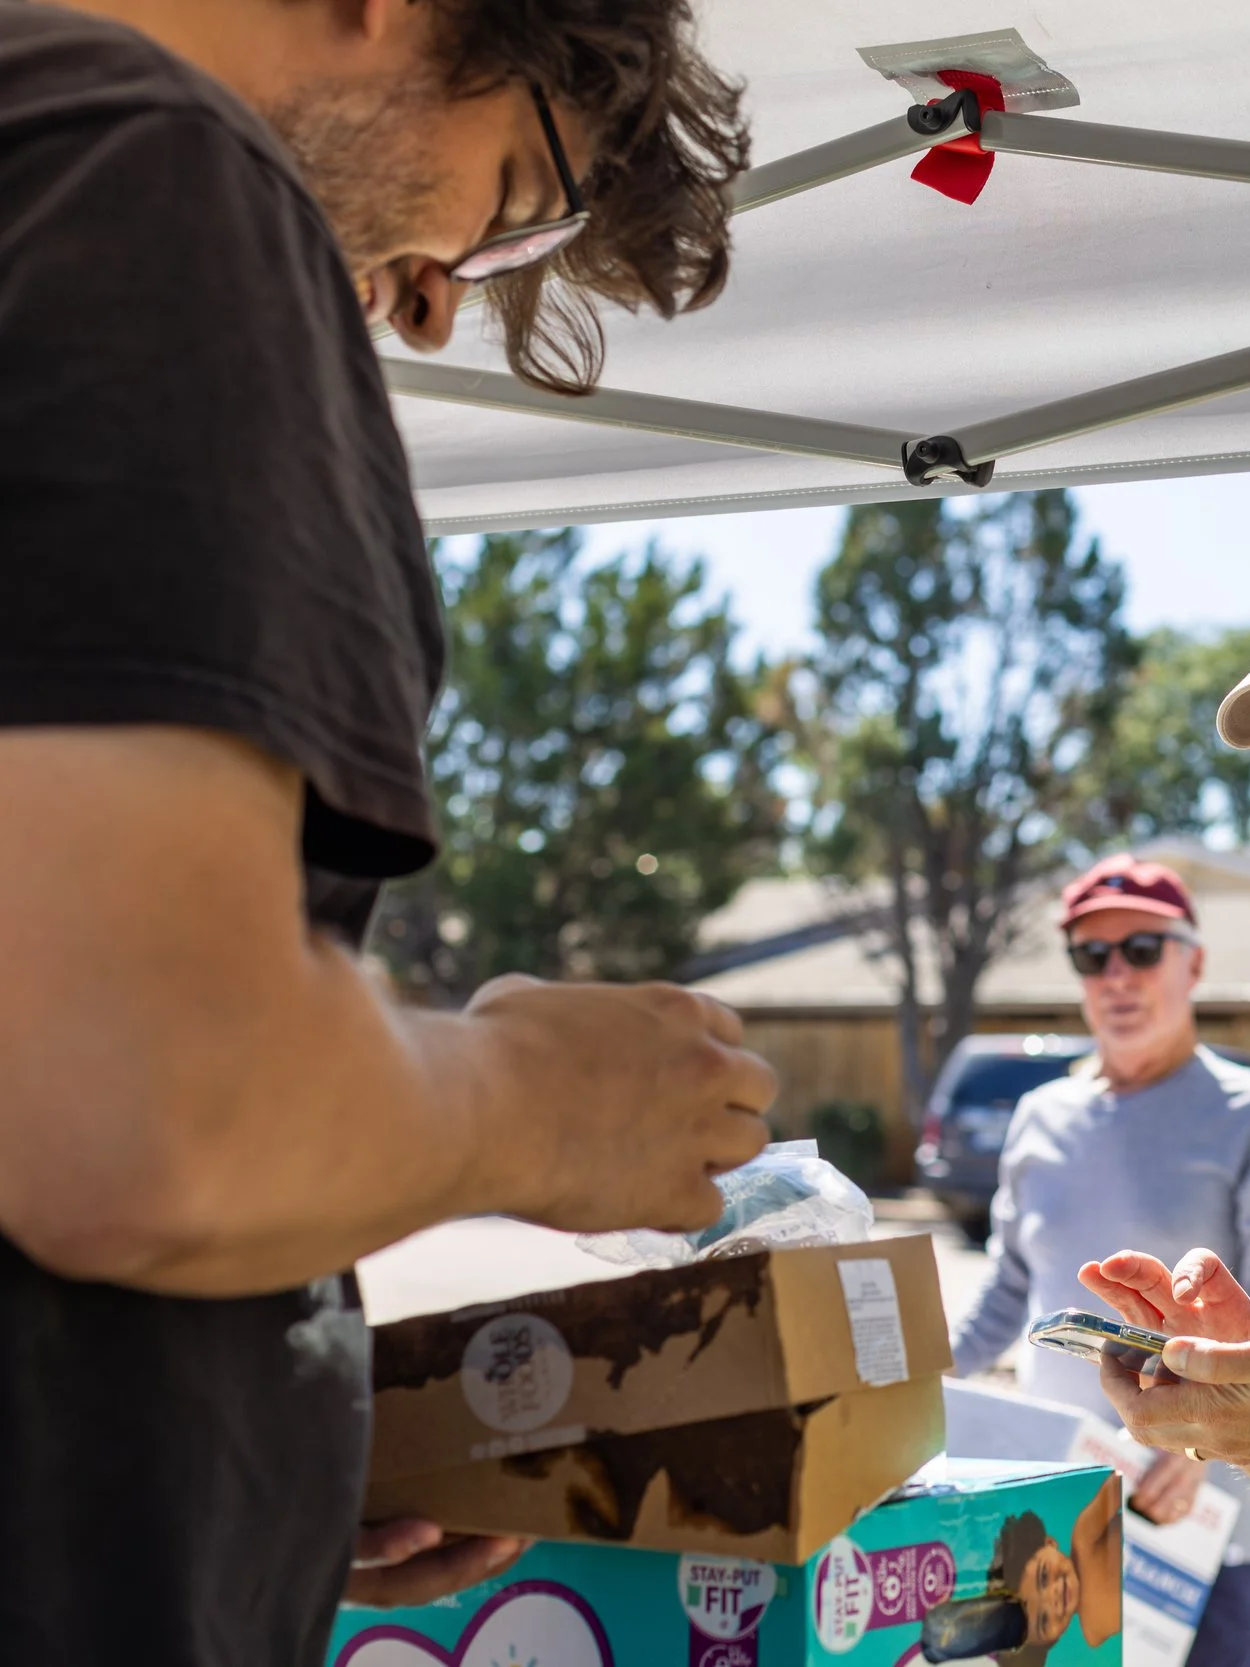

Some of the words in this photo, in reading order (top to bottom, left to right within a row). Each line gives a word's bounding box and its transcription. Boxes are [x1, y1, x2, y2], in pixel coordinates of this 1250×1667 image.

[690, 1564, 762, 1587] STAY-PUT
[705, 1585, 744, 1616] FIT
[845, 1575, 860, 1617] FIT
